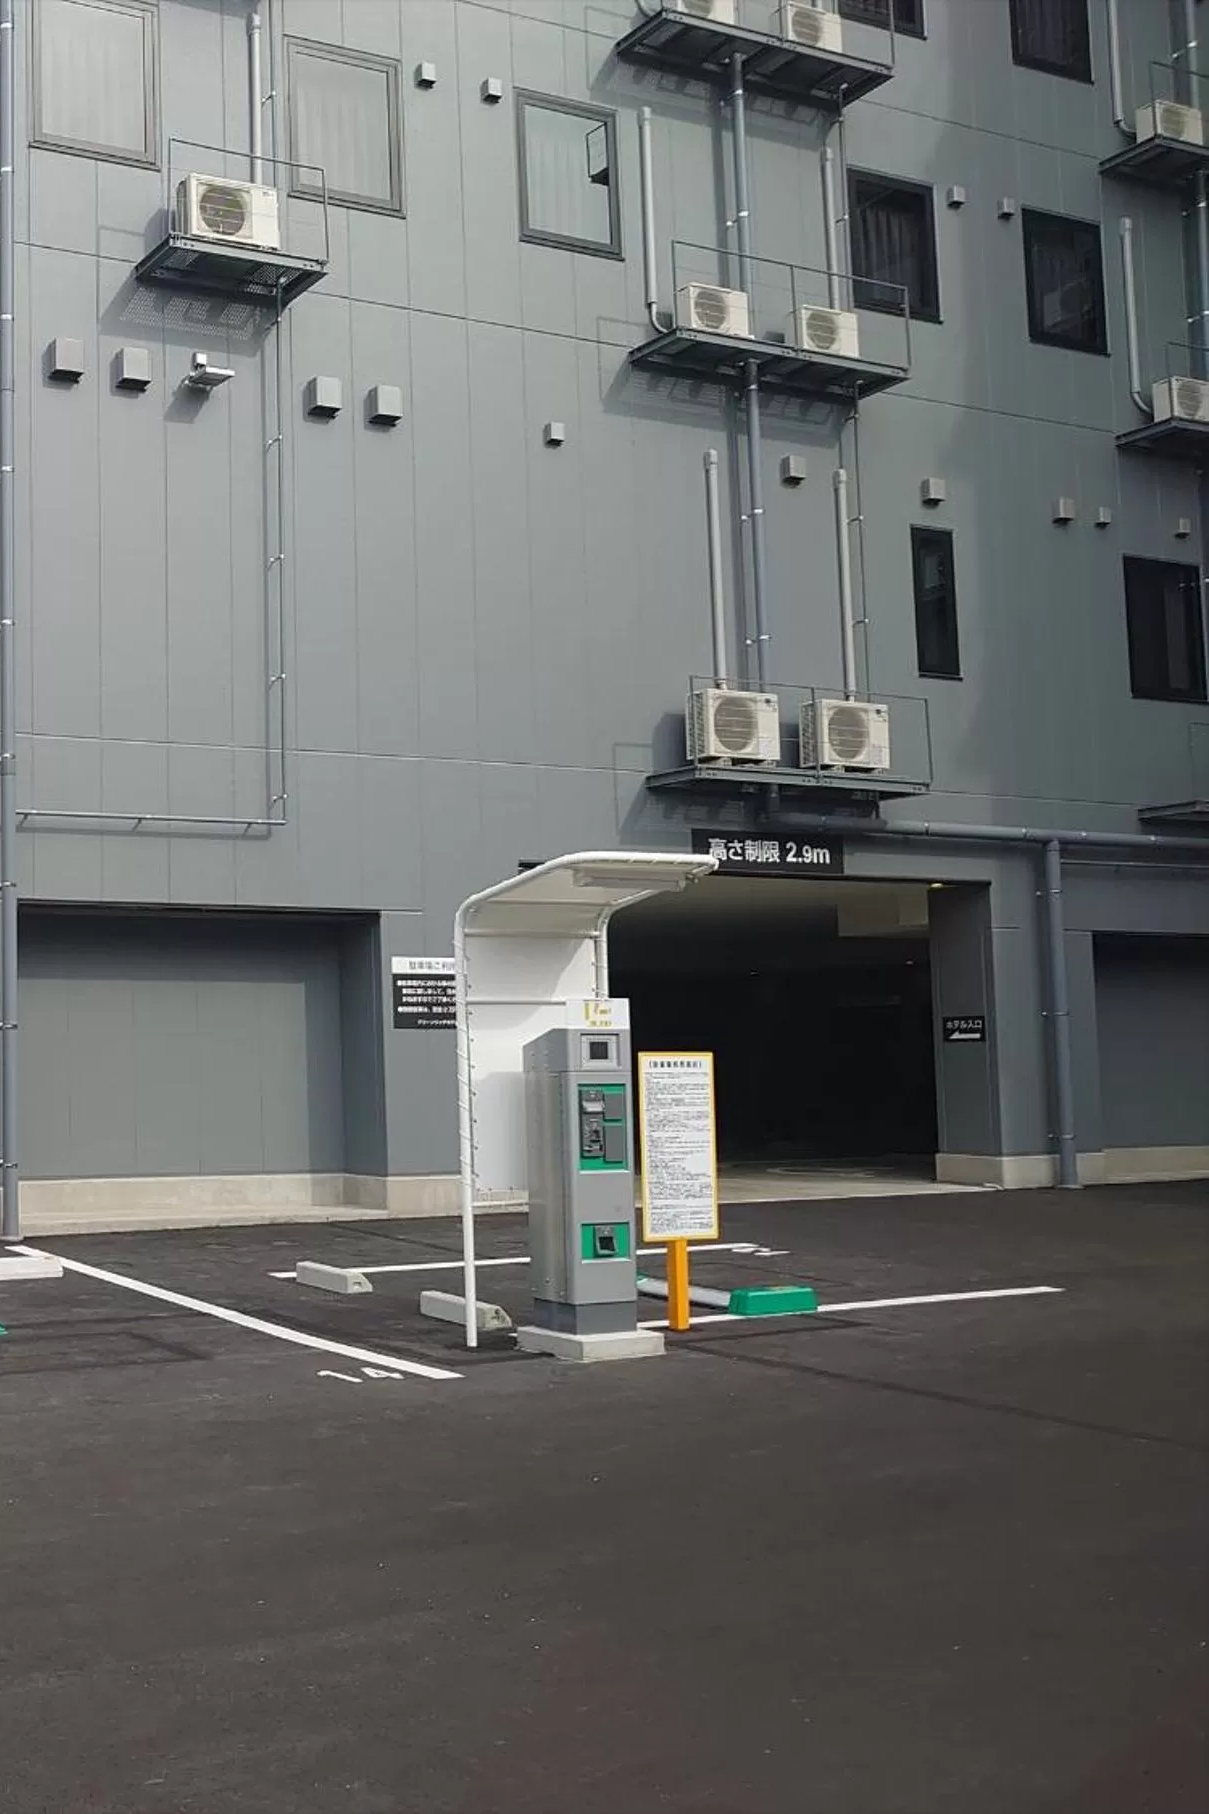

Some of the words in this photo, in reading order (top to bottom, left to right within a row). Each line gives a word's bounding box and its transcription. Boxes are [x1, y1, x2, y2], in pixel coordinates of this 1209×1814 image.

[708, 838, 780, 862] 高さ制限
[785, 841, 830, 864] 2.9m
